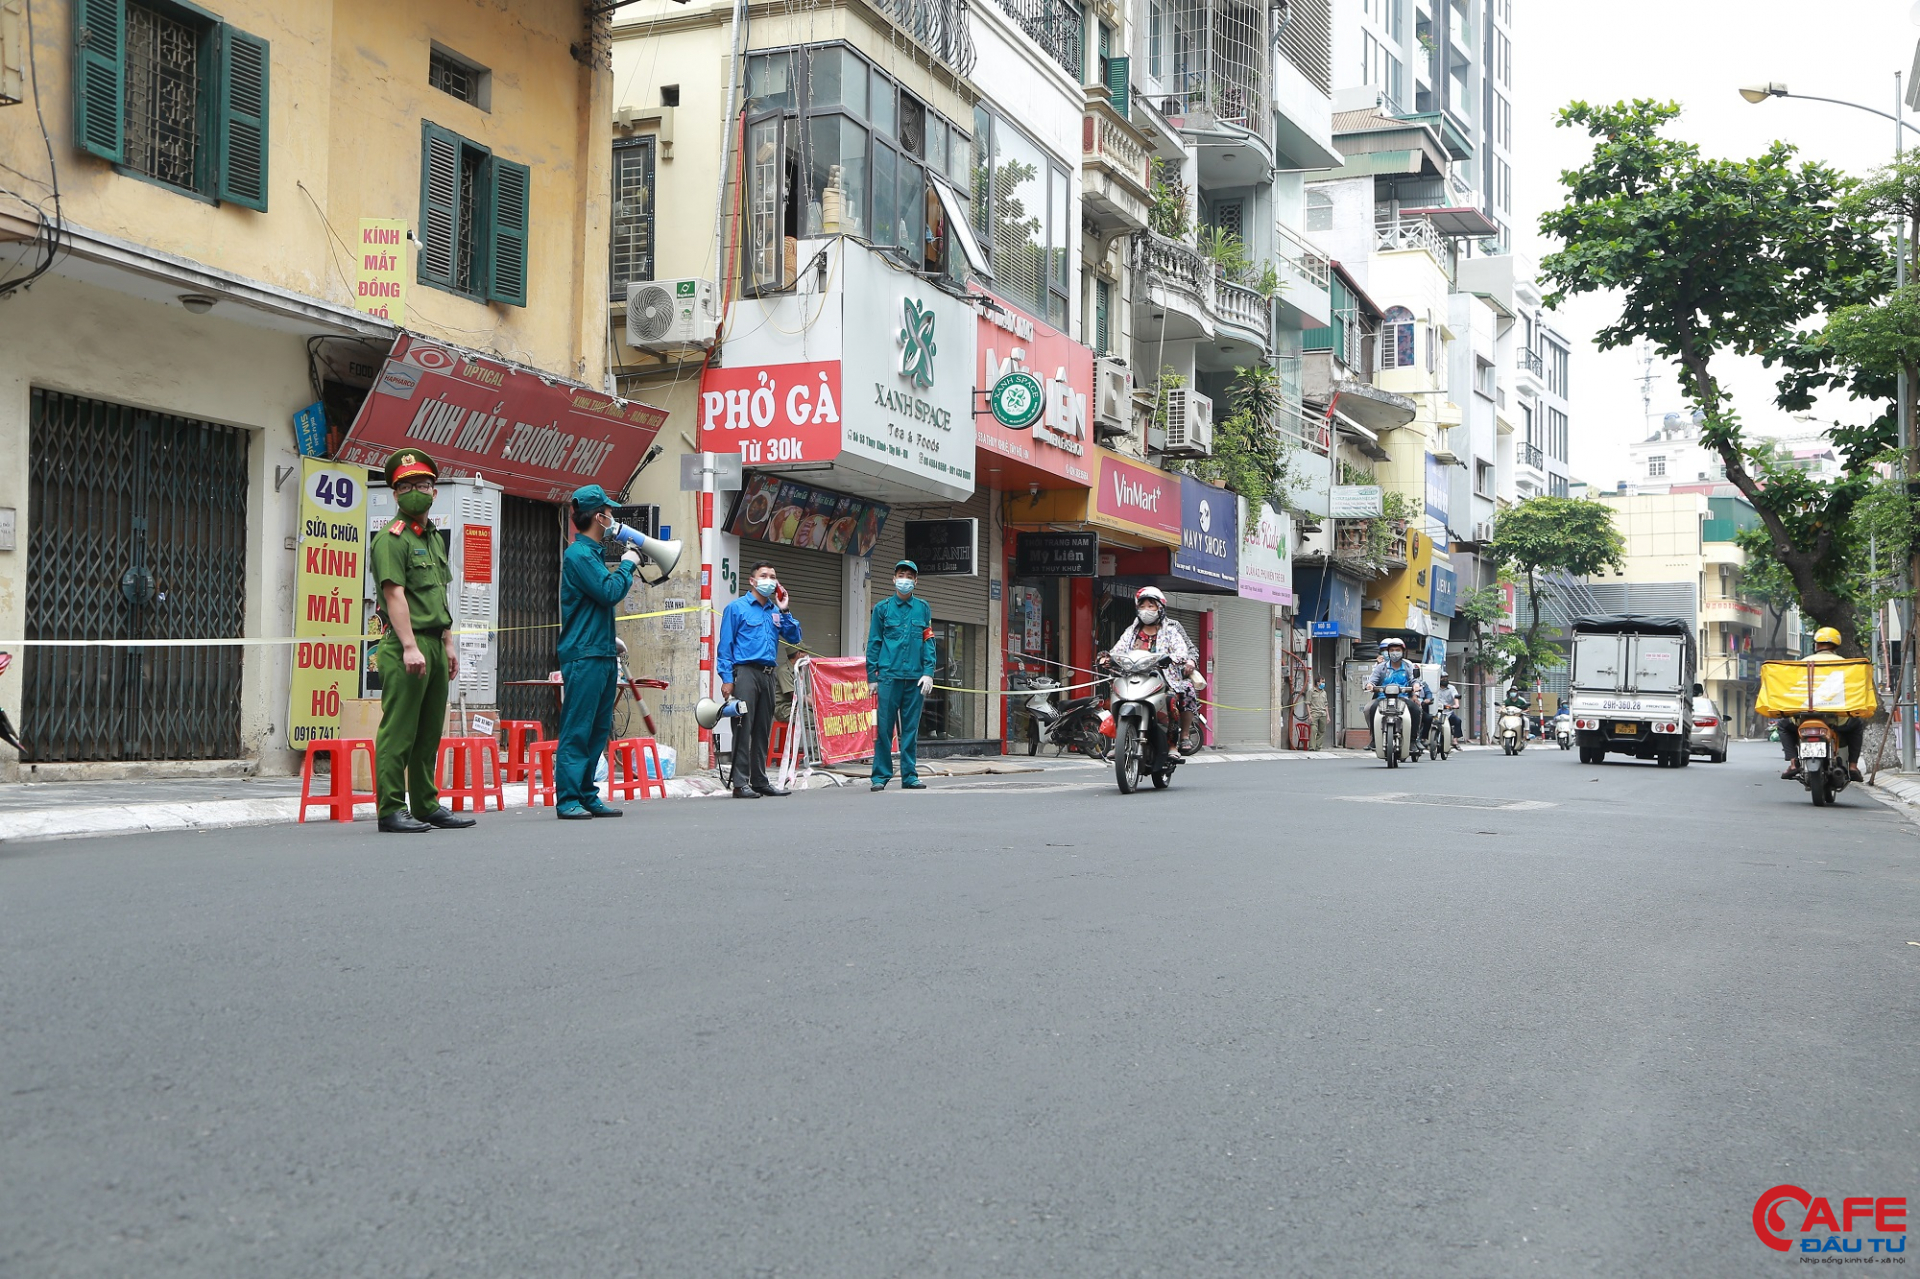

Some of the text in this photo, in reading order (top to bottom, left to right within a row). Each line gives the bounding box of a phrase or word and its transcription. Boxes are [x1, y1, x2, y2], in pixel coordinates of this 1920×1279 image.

[363, 226, 400, 245] KÍNH
[364, 249, 397, 271] MẮT
[358, 276, 400, 298] ĐỒNG
[349, 361, 374, 379] FOOD
[384, 374, 415, 388] HAPHARCO
[462, 364, 505, 387] OPTICAL
[993, 376, 1039, 399] XANH SPACE
[702, 370, 840, 431] PHỞ GÀ
[874, 382, 914, 418] XANH
[914, 398, 952, 432] SPACE
[300, 413, 311, 435] SIM
[405, 391, 467, 446] KÍNH
[453, 400, 508, 455] MẮT
[563, 434, 615, 477] PHÁT
[887, 422, 940, 453] Tea & Foods
[738, 436, 804, 463] Từ 30k
[315, 474, 354, 508] 49
[305, 515, 359, 543] SỬA CHỮA
[932, 546, 971, 561] XANH
[1044, 538, 1070, 547] TRANG
[1071, 538, 1090, 546] NAM
[1183, 528, 1203, 551] NAVY
[1204, 535, 1227, 559] SHOES
[306, 543, 358, 579] KÍNH
[1053, 549, 1085, 561] Liên
[306, 587, 353, 625] MẮT
[311, 681, 341, 718] HỒ
[1602, 699, 1642, 711] 29H-360.28
[294, 725, 334, 742] 0916 741
